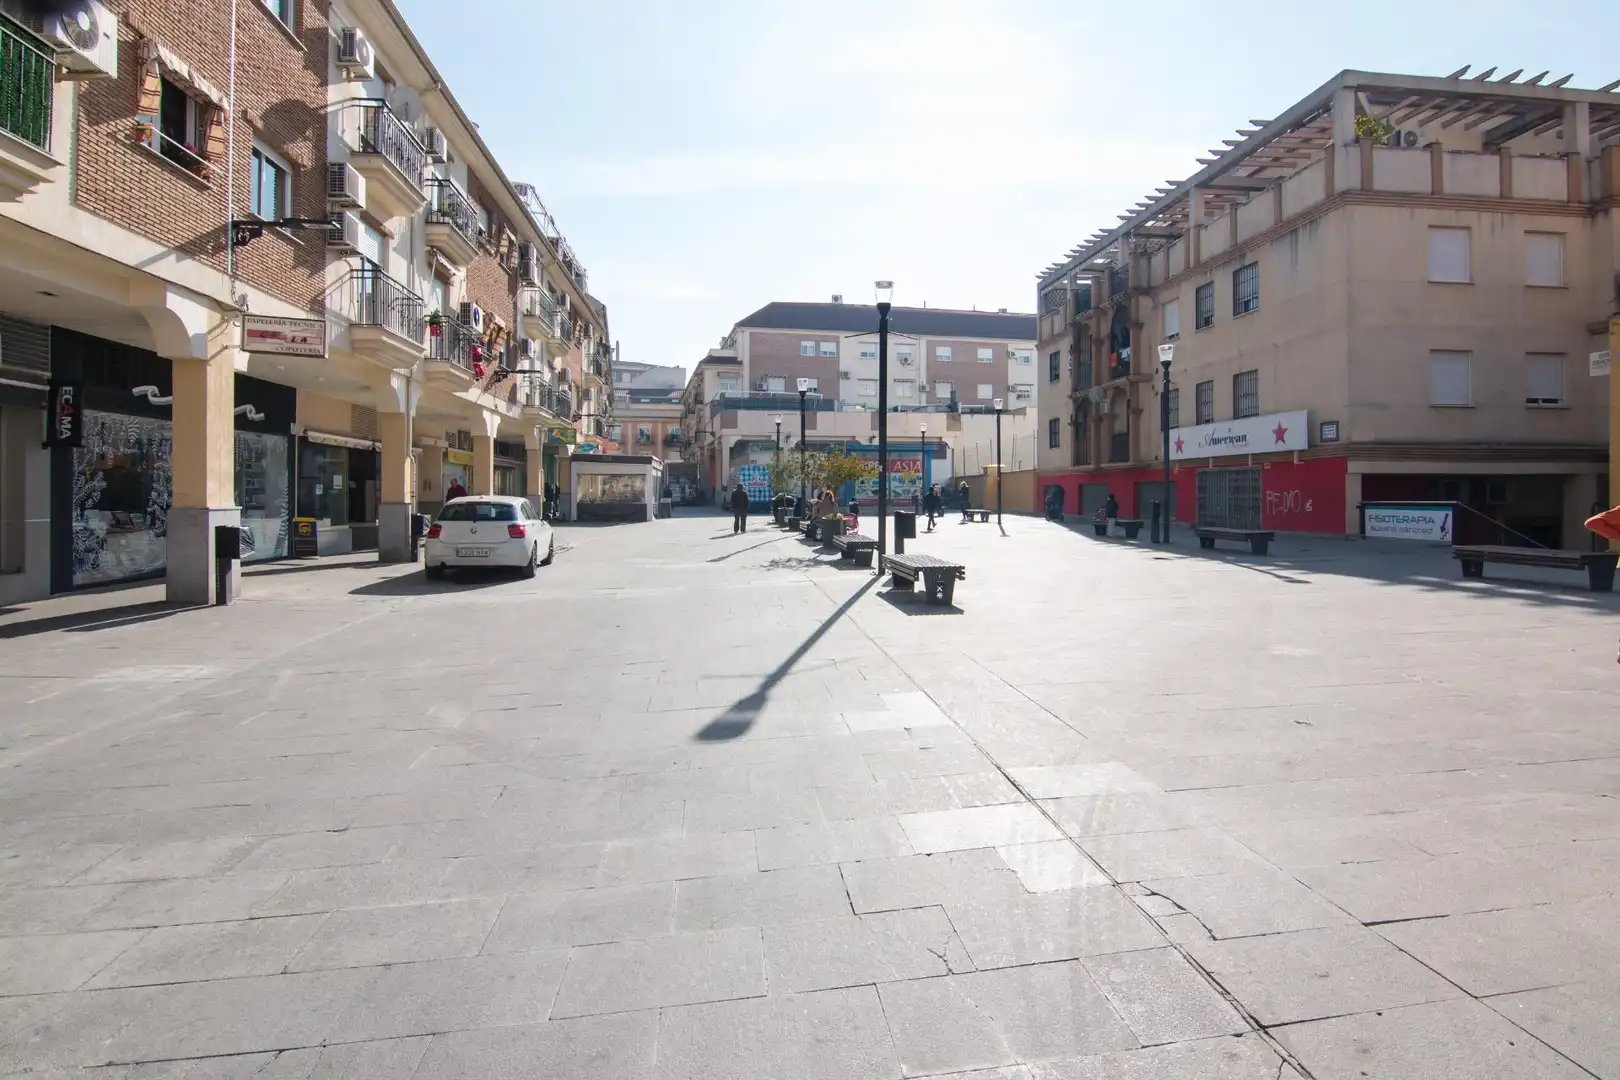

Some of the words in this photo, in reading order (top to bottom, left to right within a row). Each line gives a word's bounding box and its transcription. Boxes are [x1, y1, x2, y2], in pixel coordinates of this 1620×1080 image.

[60, 386, 73, 439] ECAMA
[893, 461, 922, 472] ASIA
[1368, 514, 1436, 524] FISIOTERAPIA
